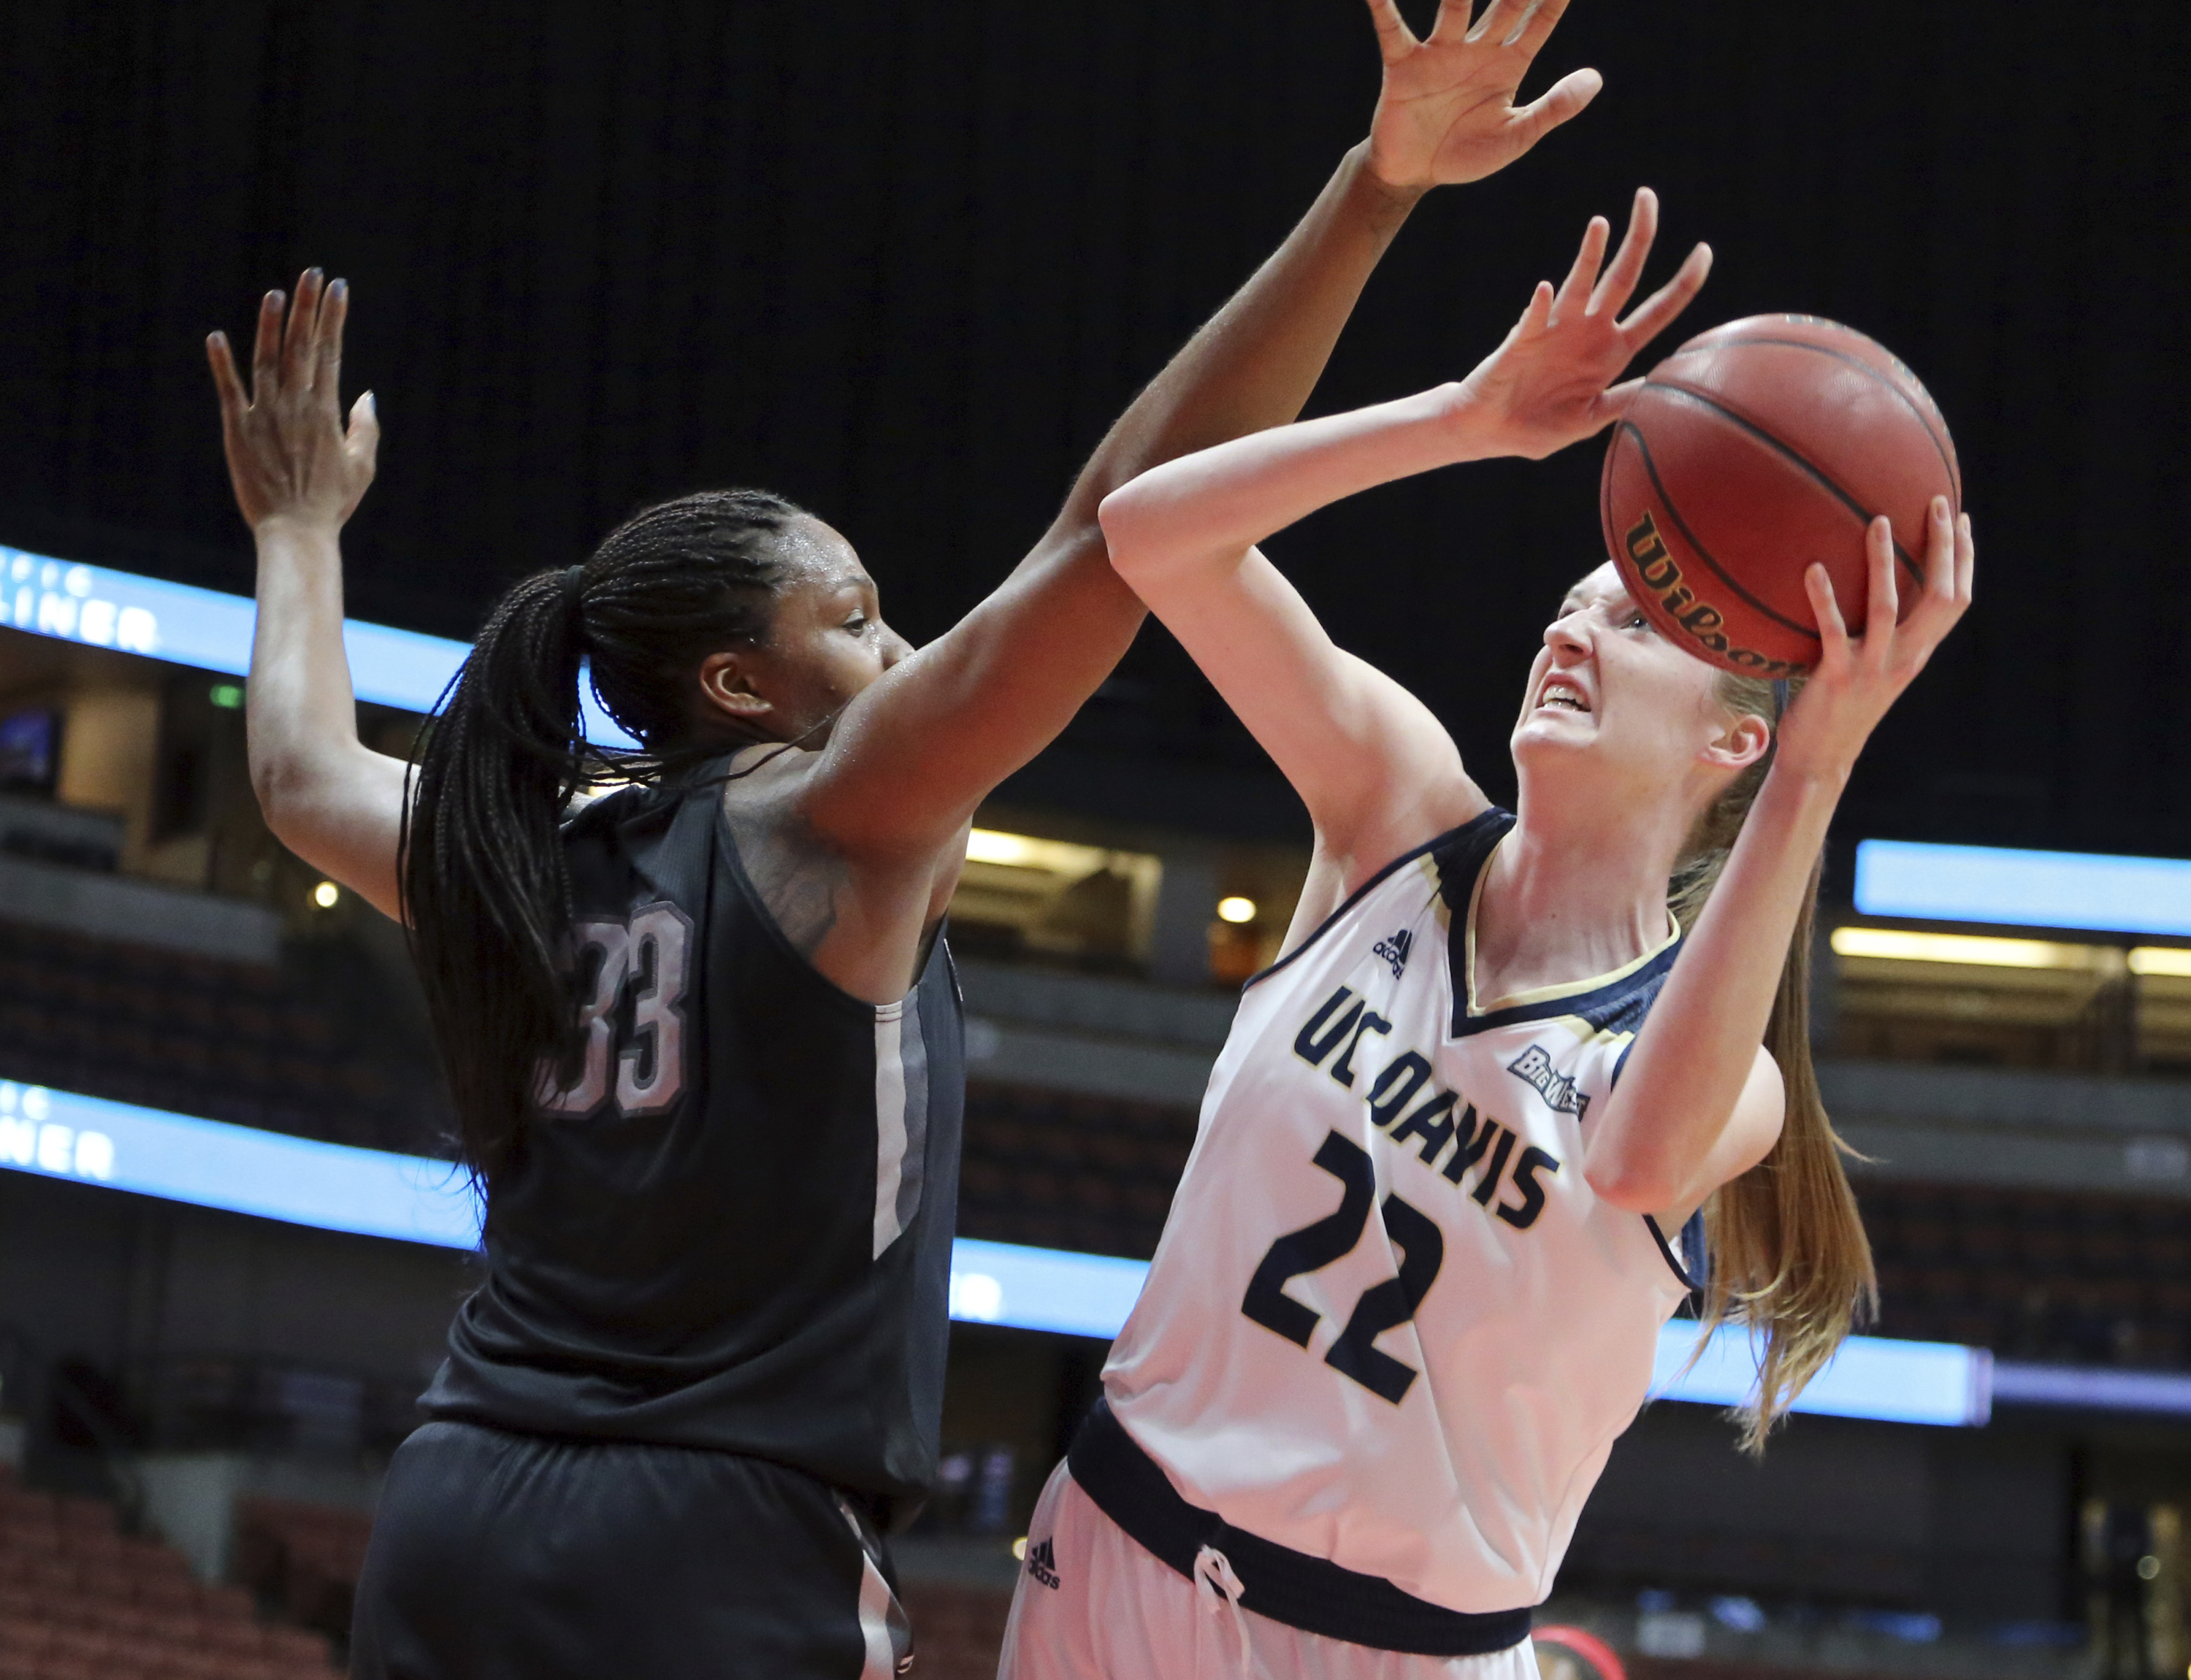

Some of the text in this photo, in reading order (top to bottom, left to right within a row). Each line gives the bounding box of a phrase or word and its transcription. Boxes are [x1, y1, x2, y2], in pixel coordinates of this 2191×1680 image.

[1626, 510, 1810, 673] Wilson
[531, 902, 694, 1119] 33
[1373, 942, 1404, 981] addas
[1293, 984, 1561, 1230] UC DAVIS
[1241, 1128, 1445, 1407] 22
[1028, 1558, 1060, 1589] addas
